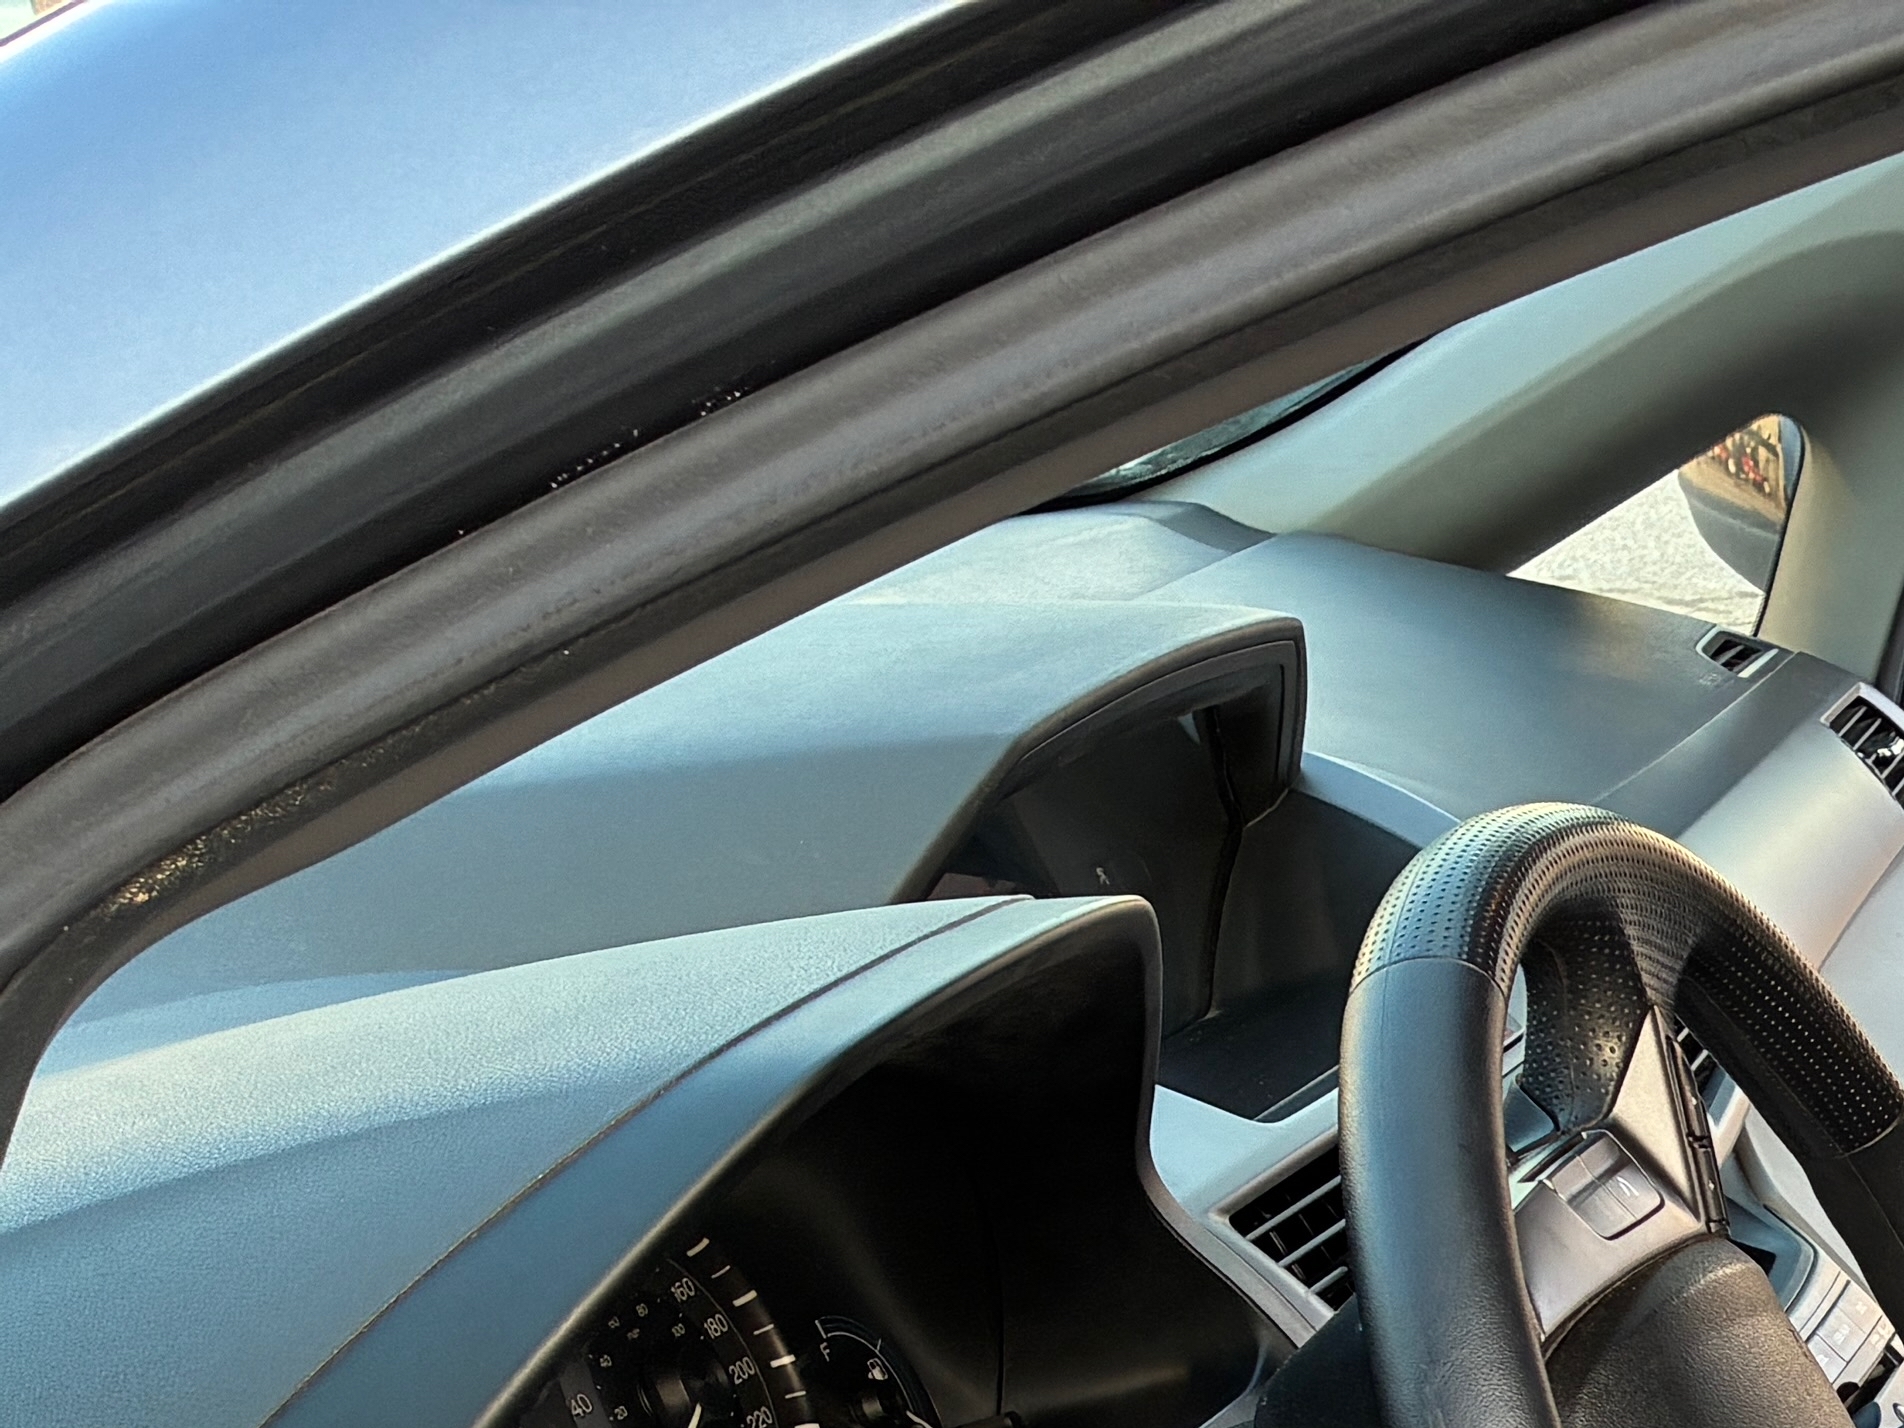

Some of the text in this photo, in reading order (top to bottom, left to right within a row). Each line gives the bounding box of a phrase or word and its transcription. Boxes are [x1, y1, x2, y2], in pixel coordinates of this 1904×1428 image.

[671, 1278, 695, 1302] 160
[704, 1313, 729, 1339] 180
[819, 1342, 831, 1362] F
[728, 1356, 756, 1385] 200
[571, 1393, 593, 1417] 40
